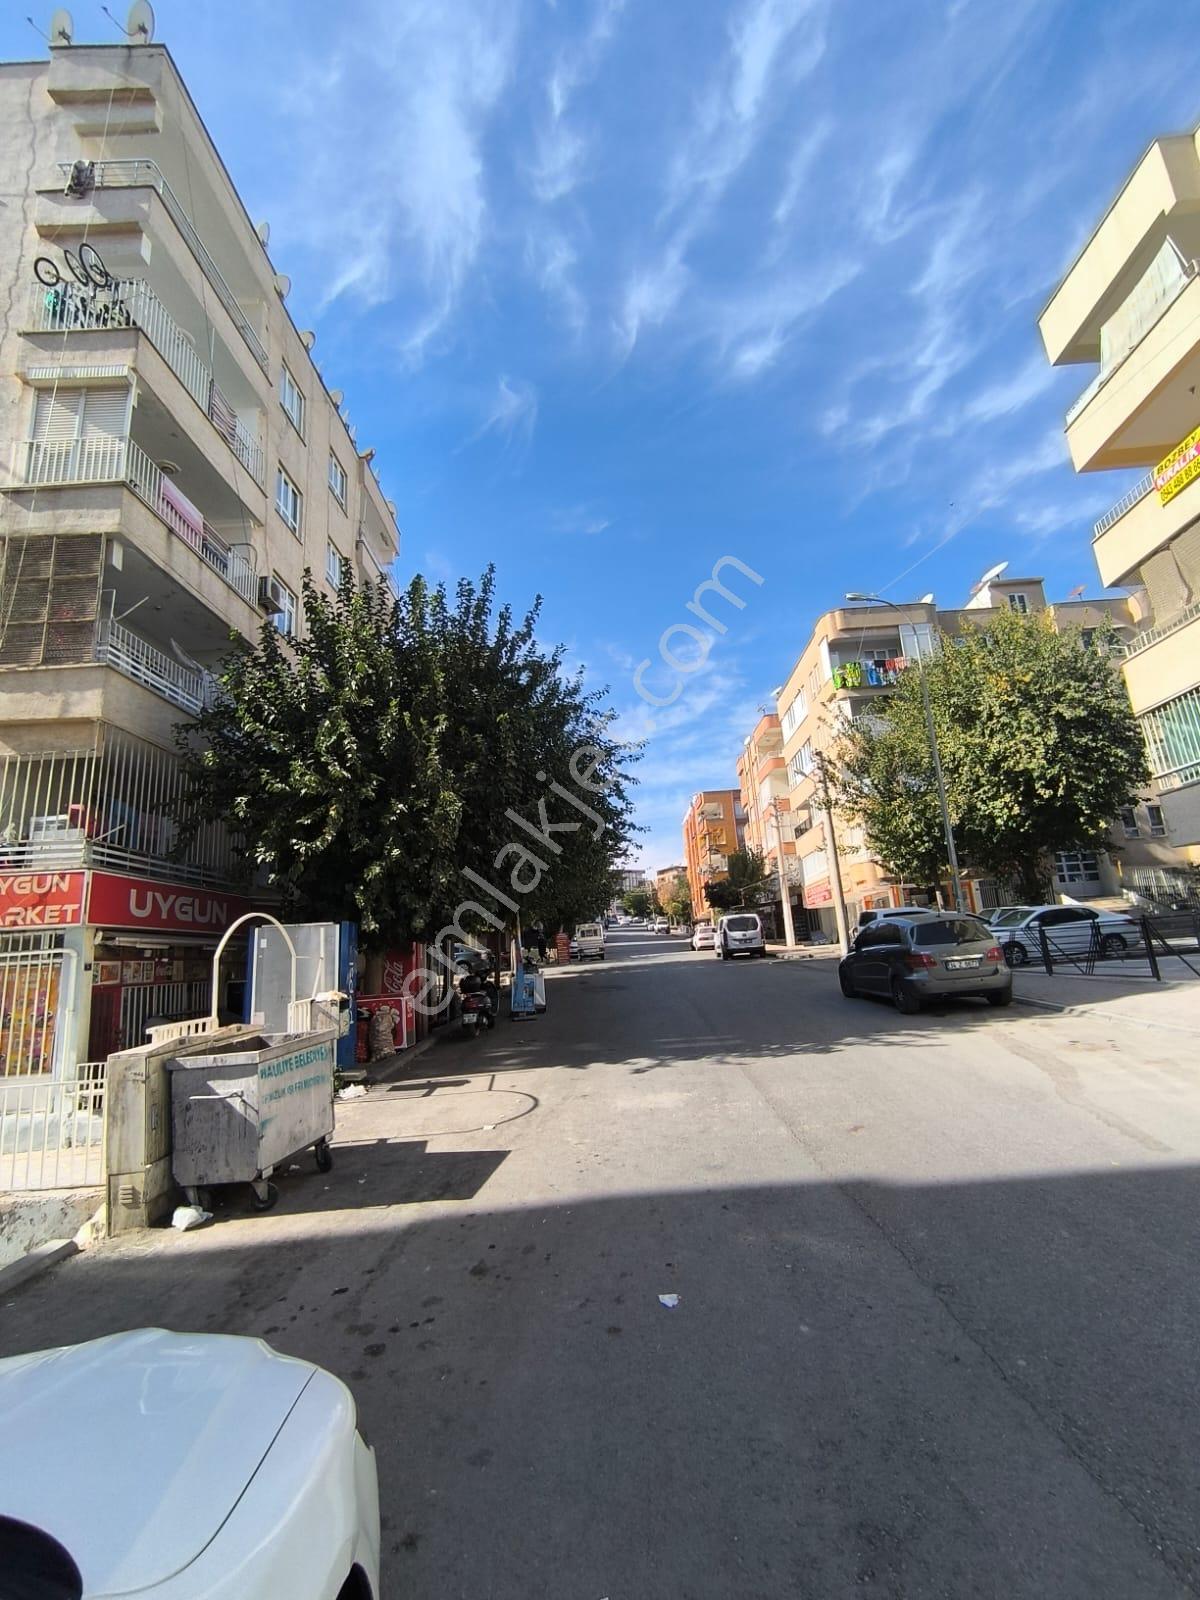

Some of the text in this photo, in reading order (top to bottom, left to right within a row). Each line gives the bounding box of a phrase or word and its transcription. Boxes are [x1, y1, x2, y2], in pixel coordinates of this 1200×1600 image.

[1156, 447, 1199, 485] KIRALIK
[0, 903, 80, 926] RKET
[129, 888, 229, 925] UYGUN
